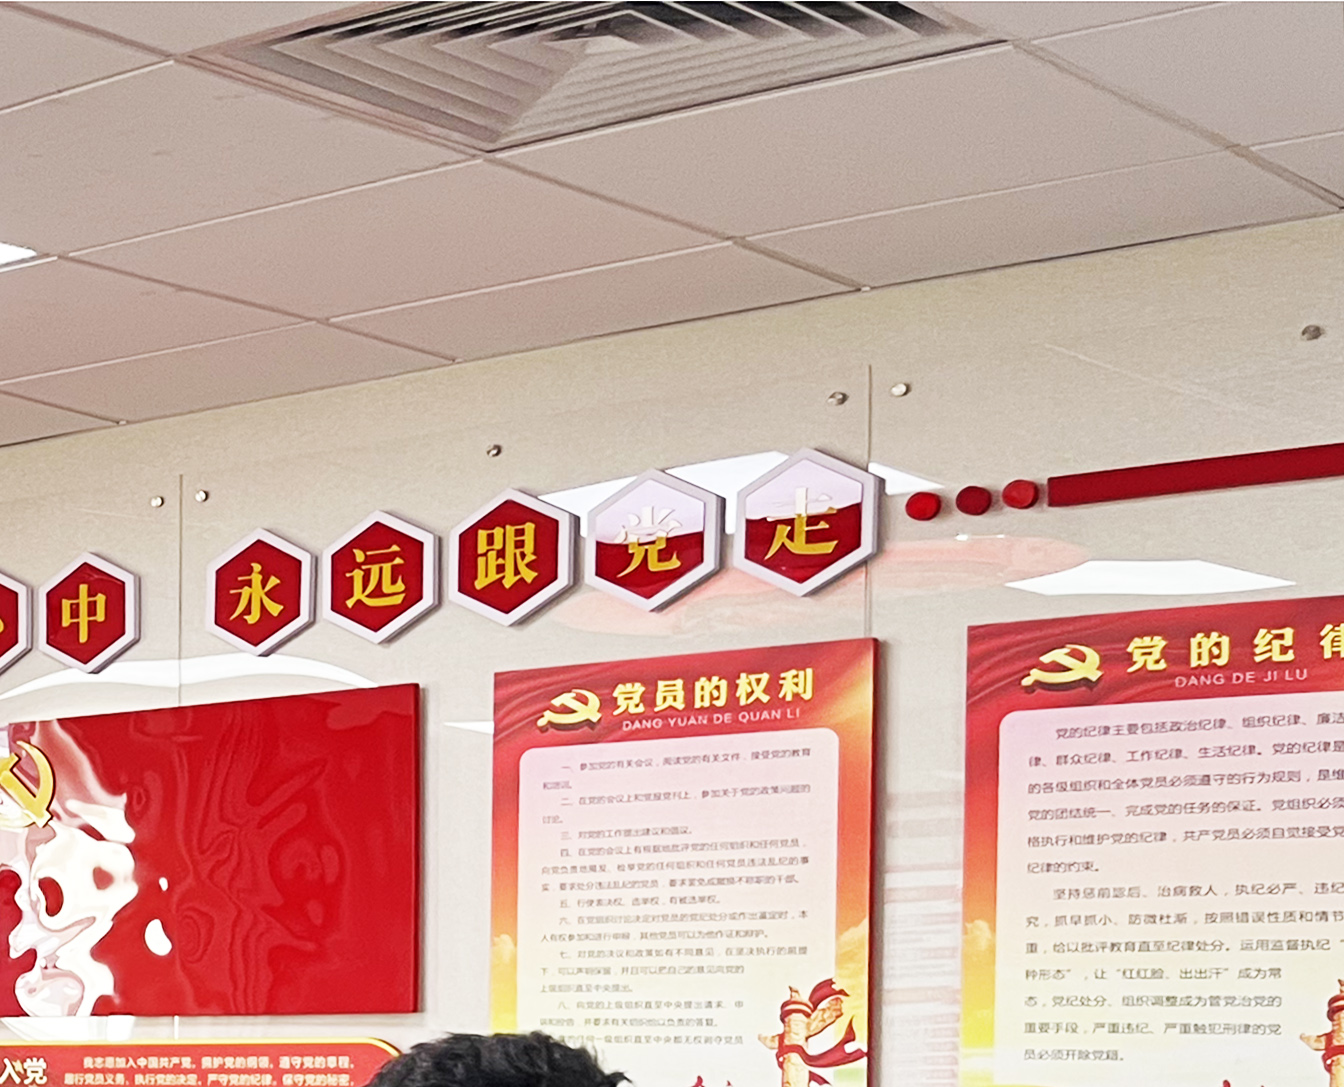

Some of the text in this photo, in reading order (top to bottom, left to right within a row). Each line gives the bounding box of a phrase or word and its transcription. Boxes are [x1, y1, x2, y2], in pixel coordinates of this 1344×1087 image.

[229, 487, 840, 625] 永远跟党走
[1126, 624, 1344, 673] 党的纪律
[612, 668, 814, 716] 党员的权利
[1175, 669, 1308, 688] DANG DE JI LU
[622, 708, 800, 731] DANG YUAN DE QUAN LI
